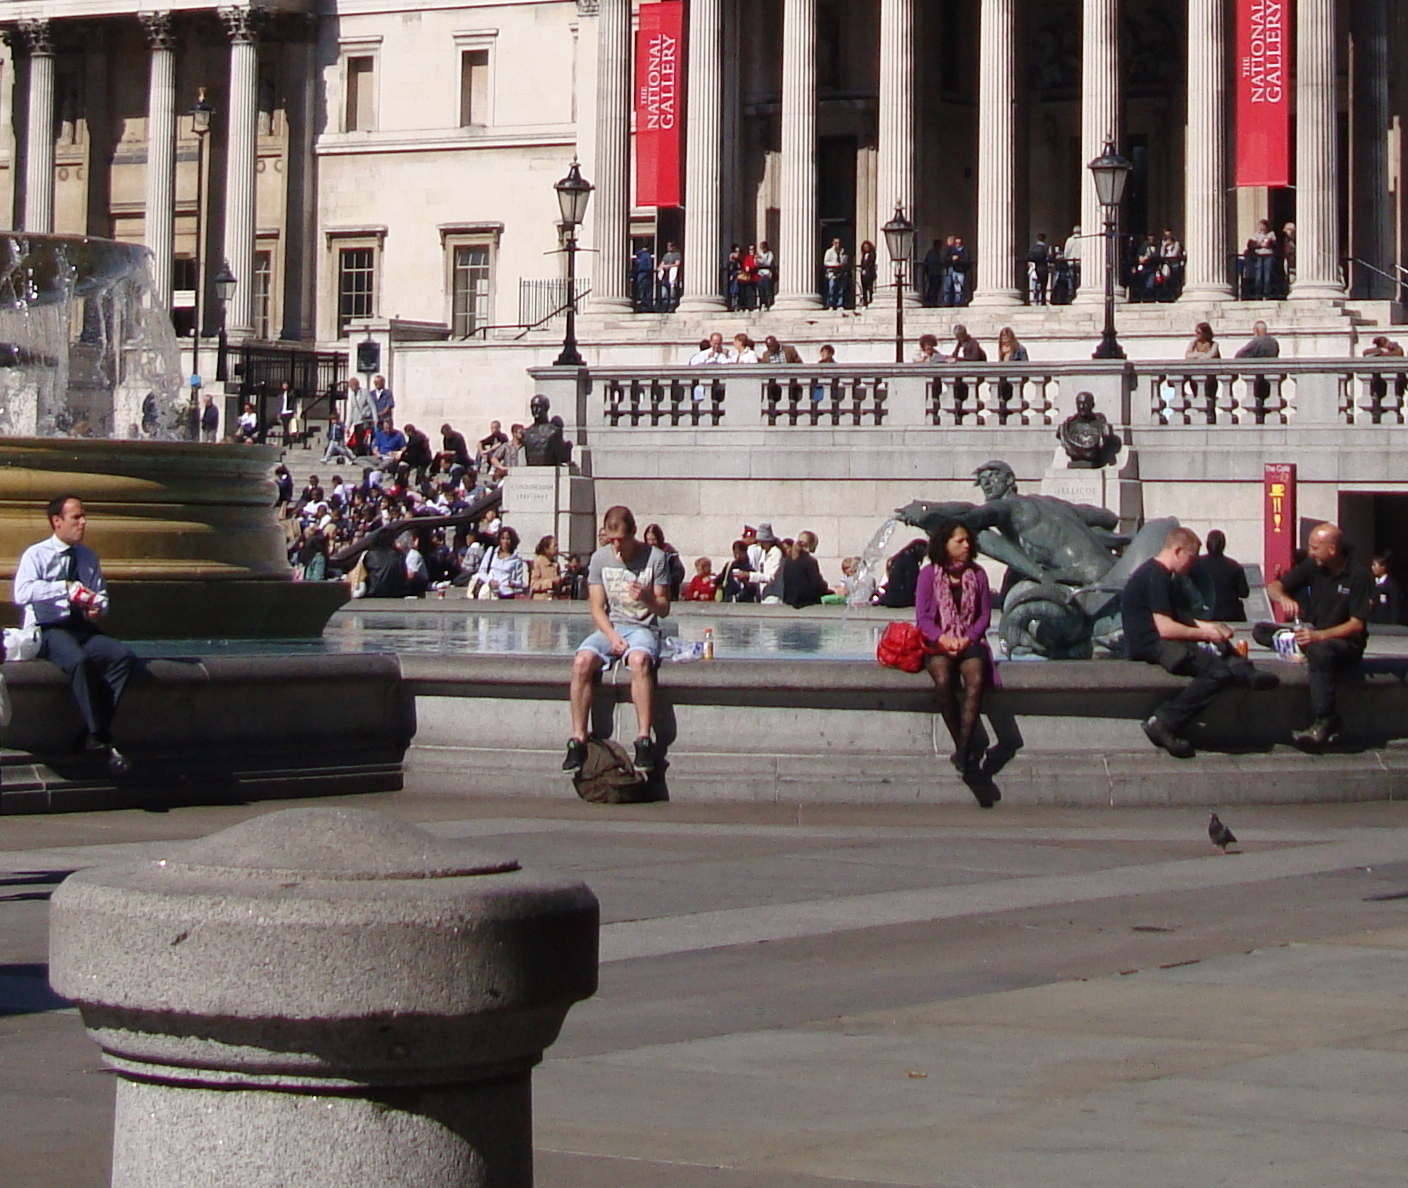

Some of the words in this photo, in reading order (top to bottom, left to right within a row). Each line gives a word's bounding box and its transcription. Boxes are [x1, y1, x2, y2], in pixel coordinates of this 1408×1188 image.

[640, 86, 648, 104] THE
[647, 34, 662, 130] NATIONAL
[660, 34, 677, 129] GALLERY
[1241, 56, 1251, 78] THE
[1250, 0, 1265, 103] NATIONAL
[1265, 0, 1282, 103] GALLERY
